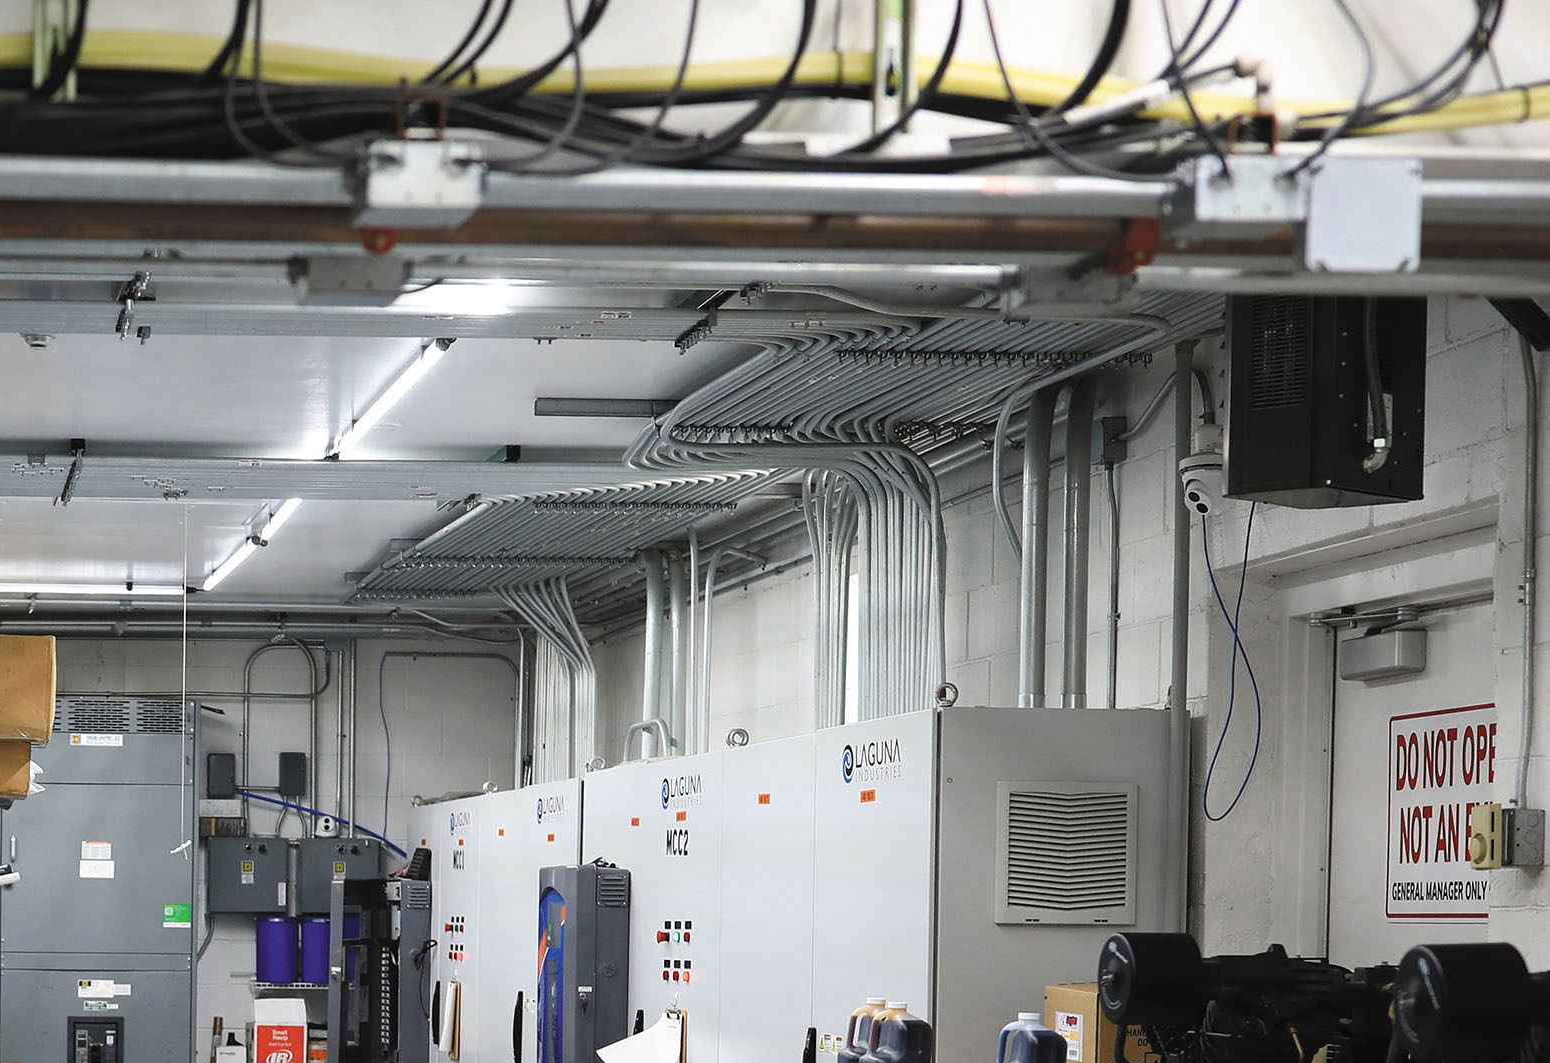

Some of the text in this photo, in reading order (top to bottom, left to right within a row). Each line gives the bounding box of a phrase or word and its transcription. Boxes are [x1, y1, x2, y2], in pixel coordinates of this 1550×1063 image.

[855, 738, 901, 768] LAGUNA
[1396, 723, 1497, 791] DO NOT OPE
[670, 774, 702, 797] LAGUNA
[855, 765, 902, 781] INDUSTRIES
[666, 829, 689, 855] MCC2
[1399, 805, 1433, 864] NOT
[1434, 803, 1460, 863] AN
[1392, 881, 1487, 900] GENERAL MANAGER ONLY
